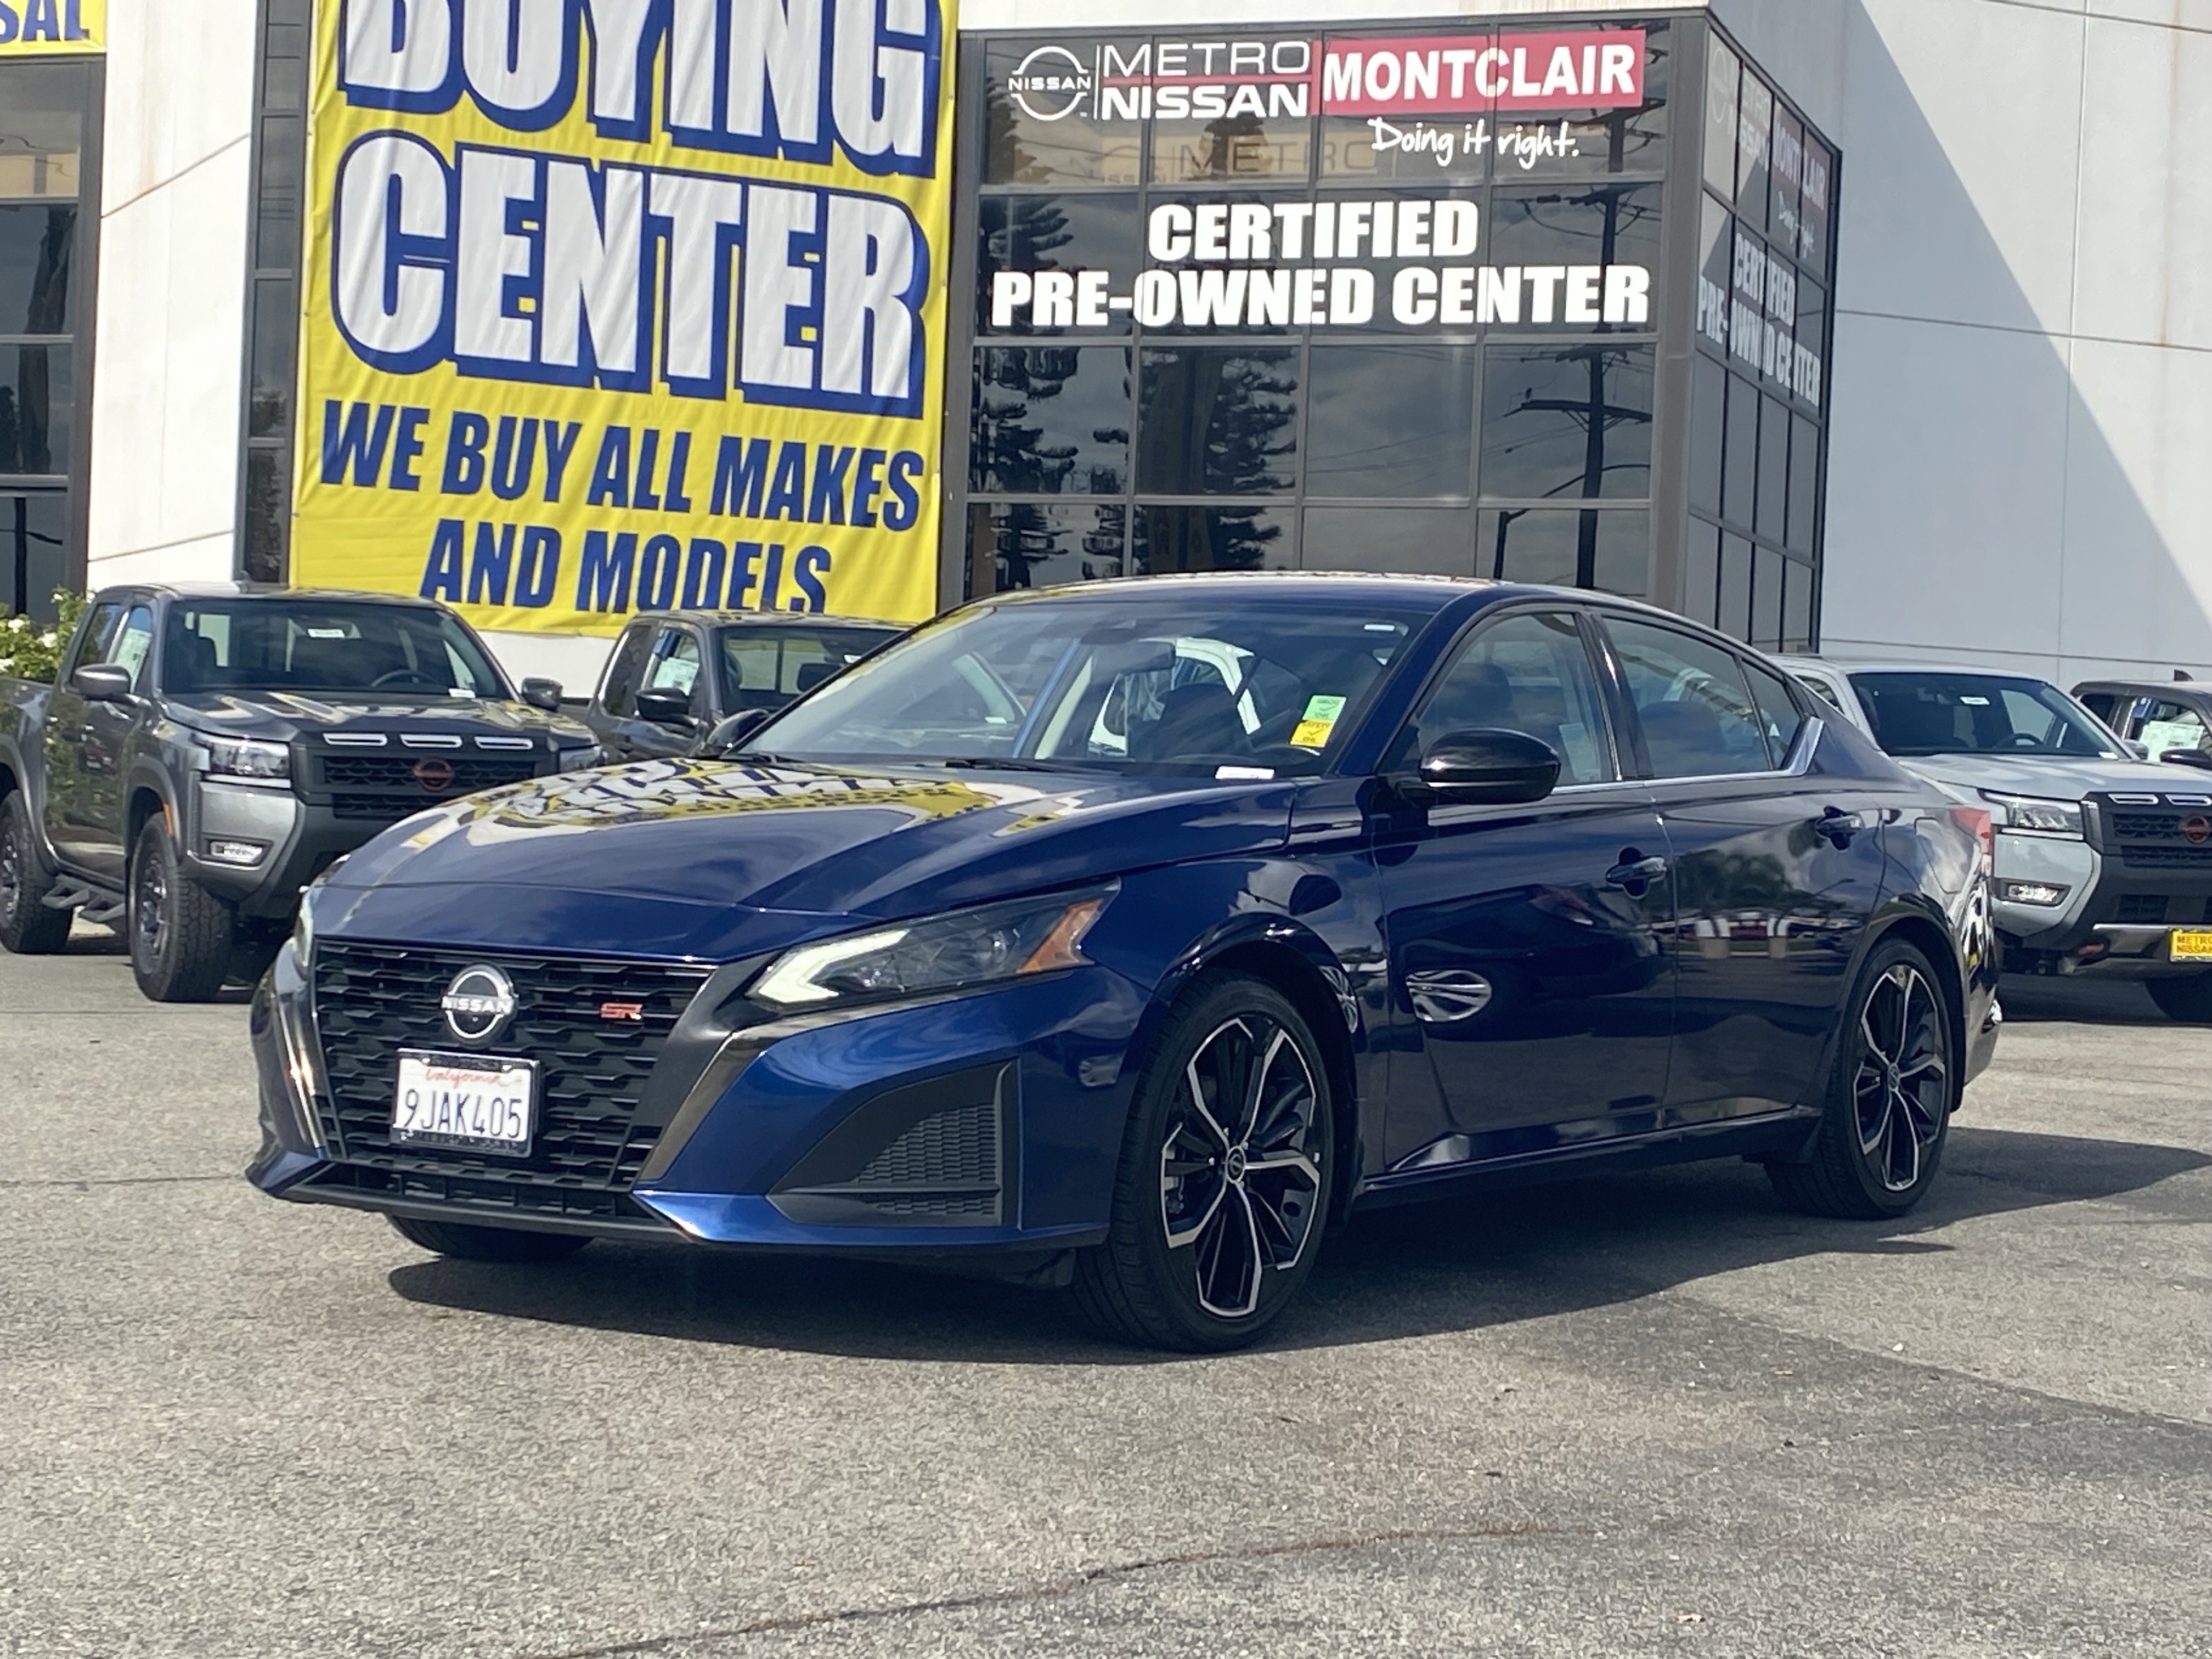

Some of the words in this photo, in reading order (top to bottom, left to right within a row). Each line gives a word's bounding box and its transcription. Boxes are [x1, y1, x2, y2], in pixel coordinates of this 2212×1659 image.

[1008, 76, 1091, 91] NISSAN
[1104, 41, 1308, 77] METRO
[1324, 44, 1636, 102] MONTCLAIR
[1101, 83, 1308, 120] NISSAN
[1367, 117, 1454, 166] Doing
[1464, 119, 1491, 154] it
[1498, 121, 1580, 169] right.
[1149, 200, 1479, 262] CERTIFIED
[332, 128, 930, 419] CENTER
[991, 267, 1375, 326] PRE-OWNED
[1392, 265, 1650, 325] CENTER
[1697, 275, 1775, 376] PRE-OWND
[320, 398, 430, 492] WE
[439, 411, 582, 503] BUY
[586, 425, 692, 513] ALL
[709, 436, 925, 533] MAKES
[419, 519, 562, 609] AND
[575, 529, 832, 613] MODELS
[441, 996, 514, 1014] NISSAN
[404, 1088, 522, 1139] 9JAK405
